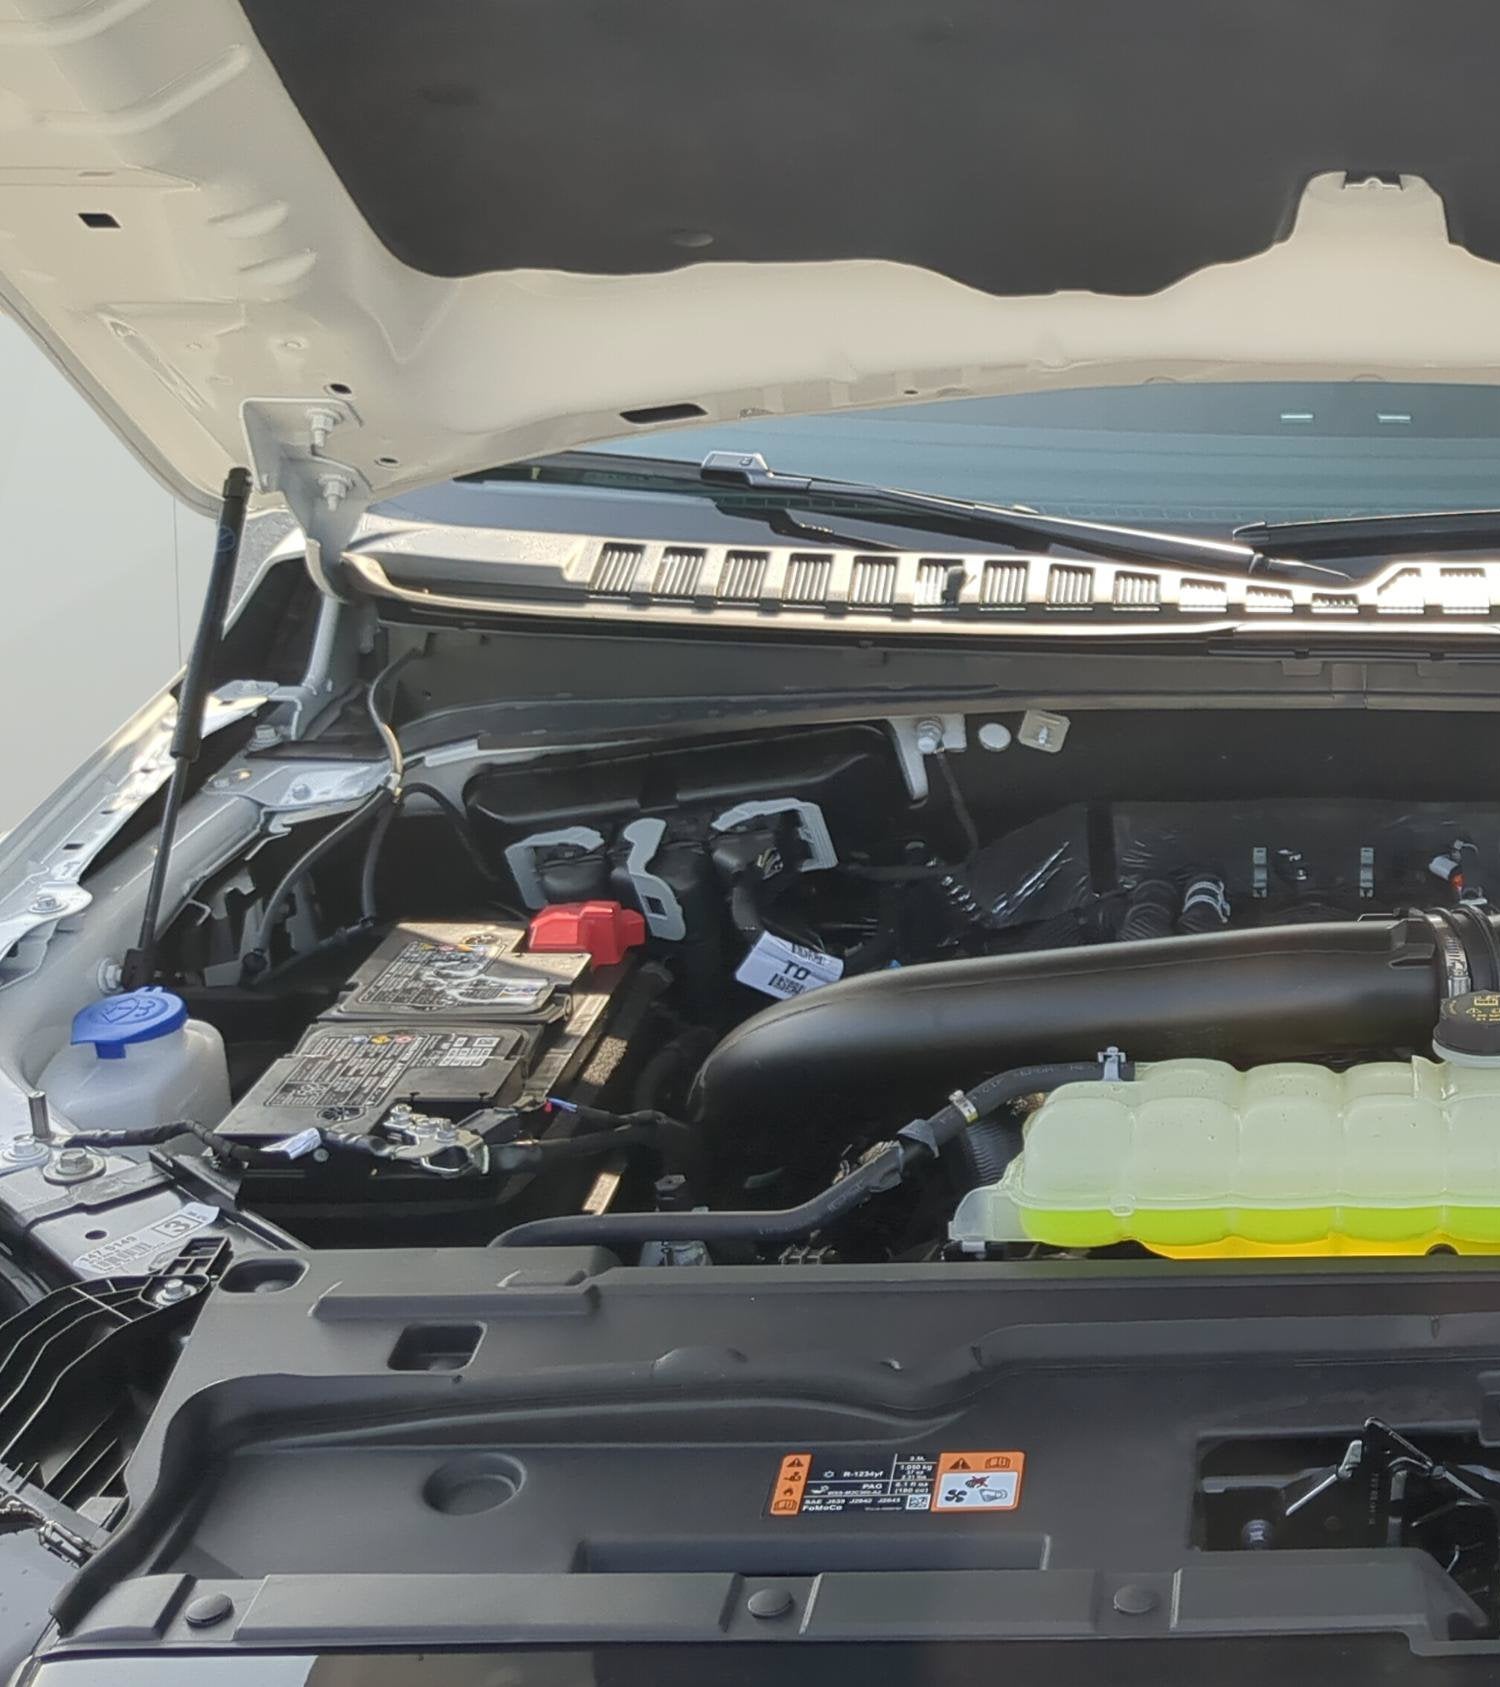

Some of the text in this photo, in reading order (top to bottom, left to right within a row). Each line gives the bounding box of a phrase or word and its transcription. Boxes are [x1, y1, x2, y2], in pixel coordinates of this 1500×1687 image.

[164, 1220, 190, 1233] 3
[843, 1470, 884, 1479] R-1234yf
[802, 1504, 843, 1512] FoMoCo
